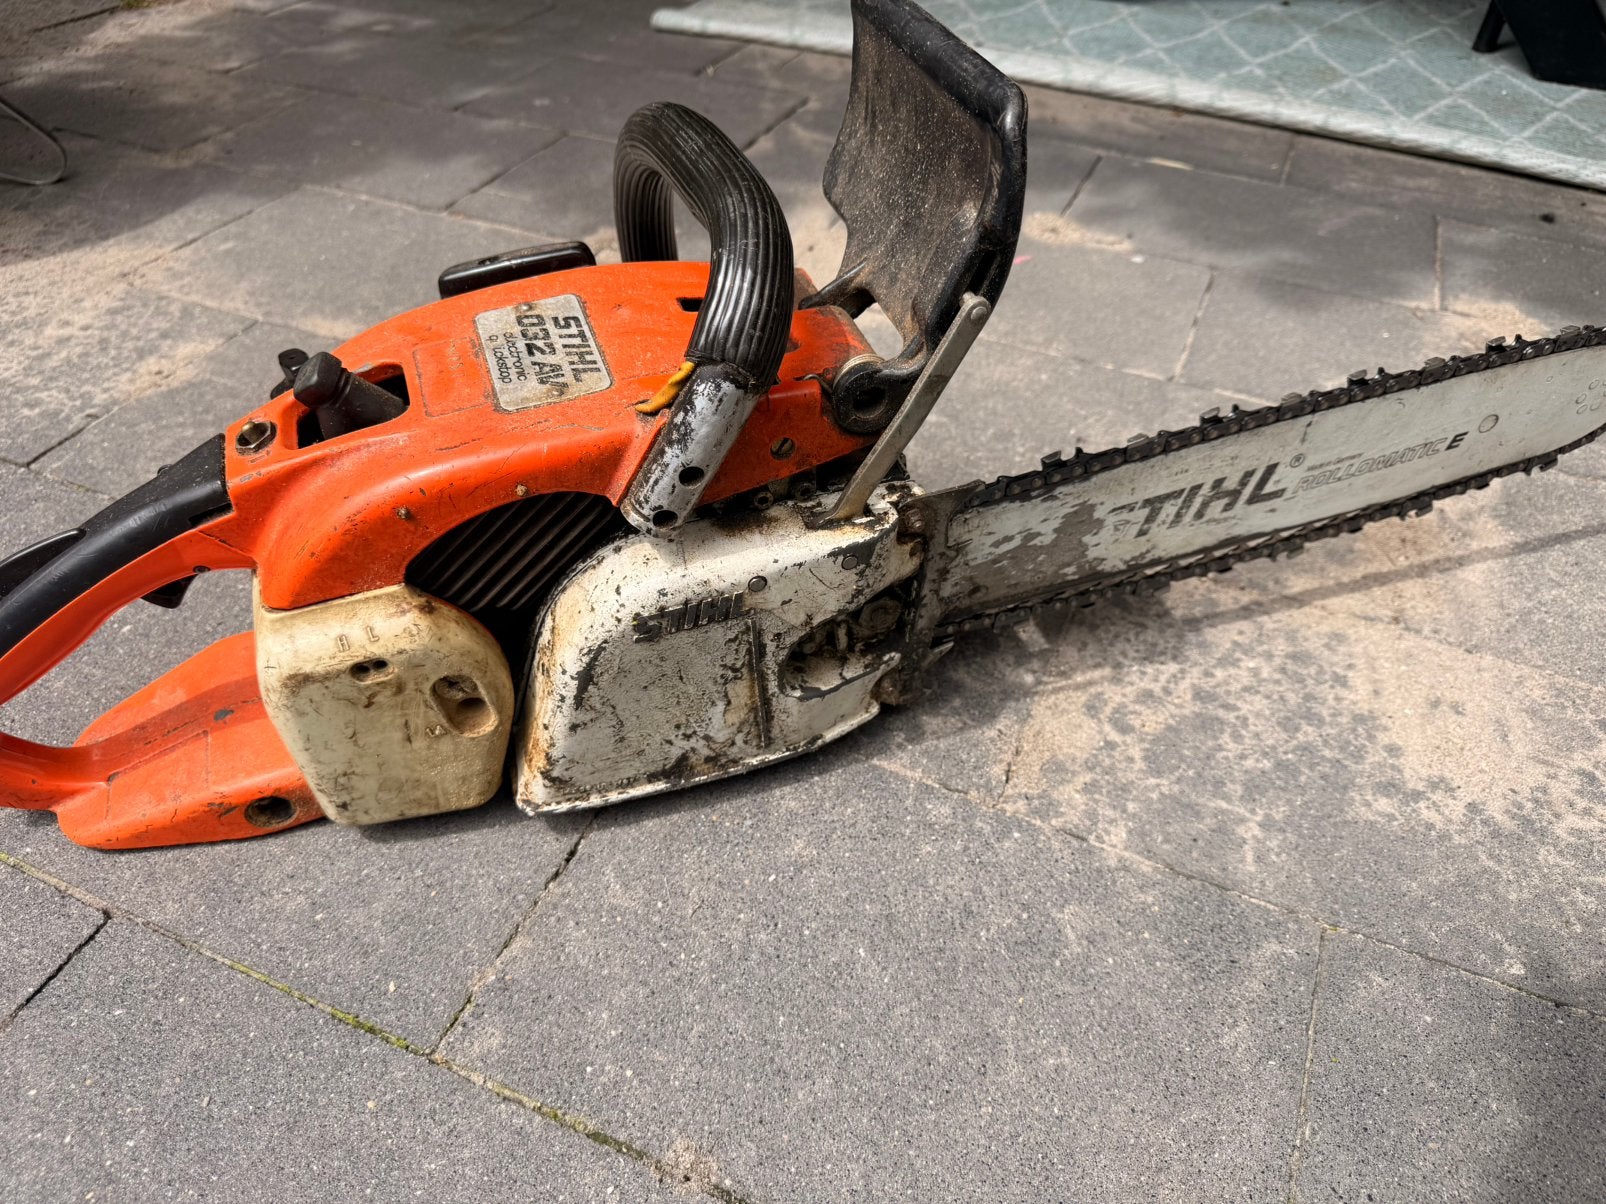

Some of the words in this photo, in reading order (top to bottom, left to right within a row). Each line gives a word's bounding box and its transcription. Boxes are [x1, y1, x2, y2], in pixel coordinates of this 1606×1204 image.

[486, 335, 512, 384] qickstop
[503, 332, 530, 382] electronic
[517, 315, 556, 357] 032
[551, 316, 601, 383] STIHL
[531, 361, 569, 389] AV
[1292, 437, 1448, 494] ROLLOMATIC
[1446, 431, 1469, 452] E
[337, 634, 350, 652] H
[366, 625, 380, 642] L
[633, 590, 753, 643] STIHL
